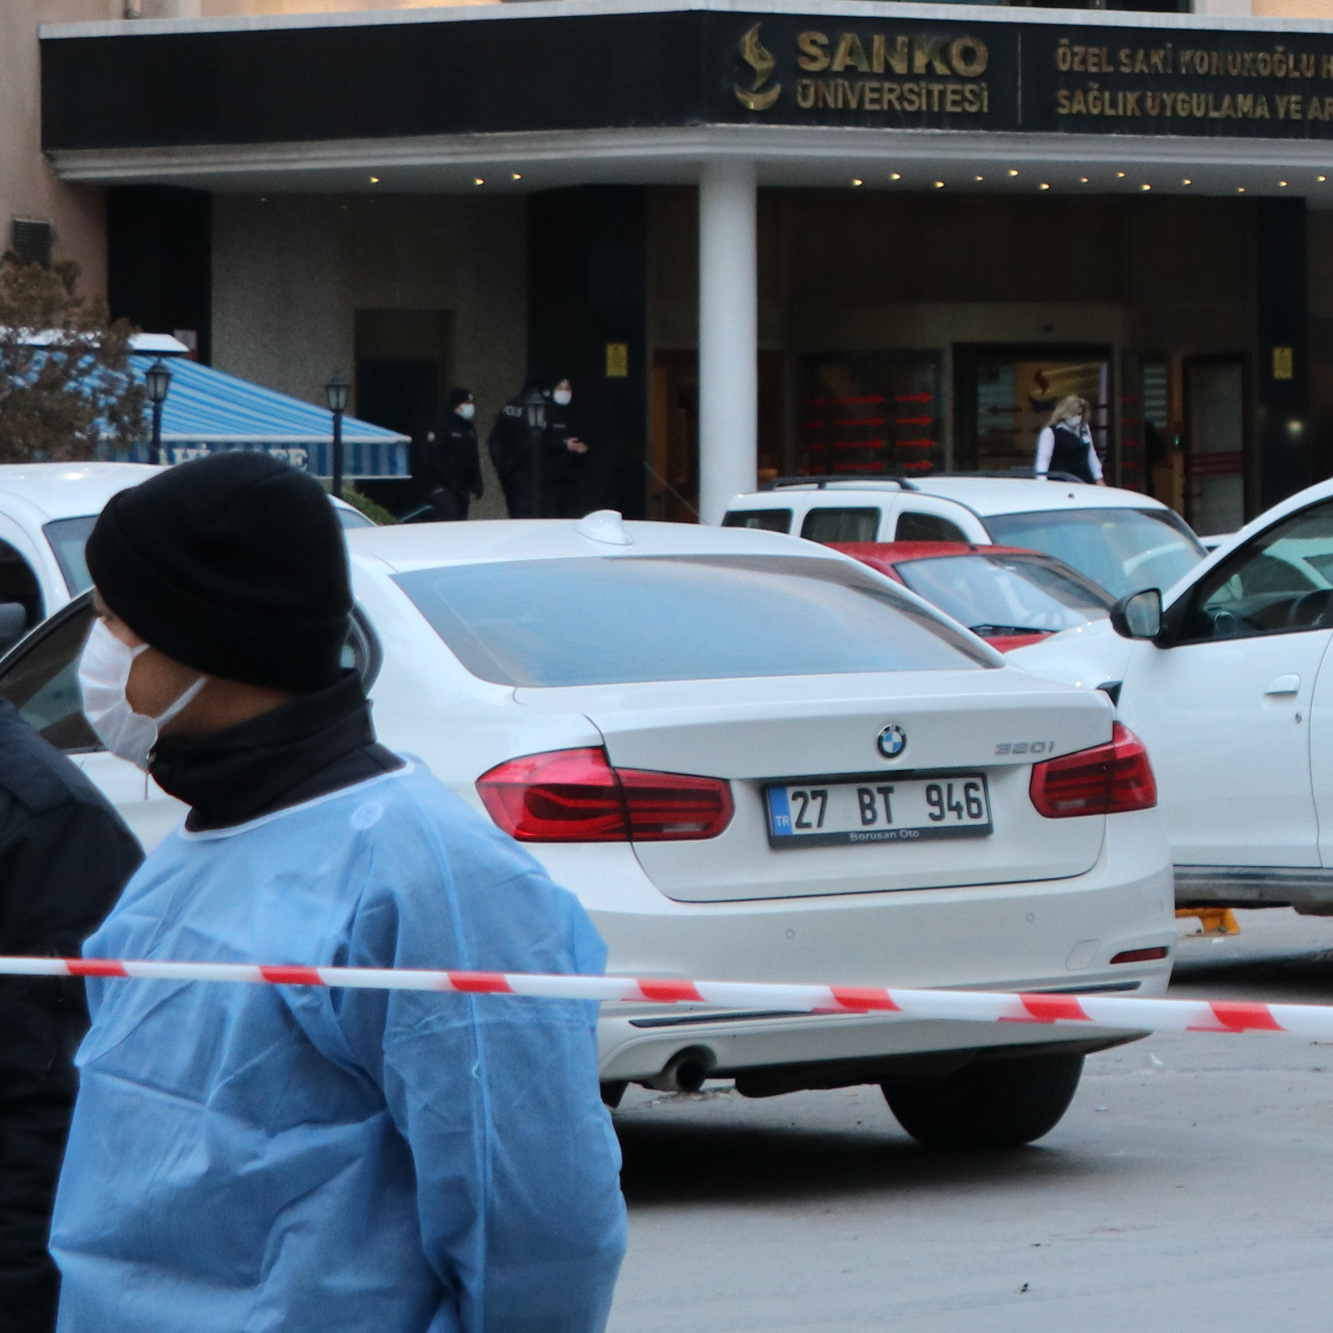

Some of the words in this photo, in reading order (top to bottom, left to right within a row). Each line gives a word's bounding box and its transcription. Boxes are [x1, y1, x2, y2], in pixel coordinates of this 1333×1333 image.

[797, 31, 988, 77] SANKO
[1057, 38, 1113, 72] ÖZEL
[1180, 45, 1315, 78] KONUKOĞLU
[796, 79, 988, 112] ÜNİVERSİTESİ
[1057, 82, 1141, 116] SAĞLIK
[1144, 92, 1270, 119] UYGULAMA
[1275, 94, 1302, 120] VE
[775, 815, 790, 827] TR
[791, 789, 828, 829] 27
[856, 786, 895, 826] BT
[925, 782, 983, 821] 946
[850, 830, 897, 842] Borusan
[900, 829, 920, 839] Oto
